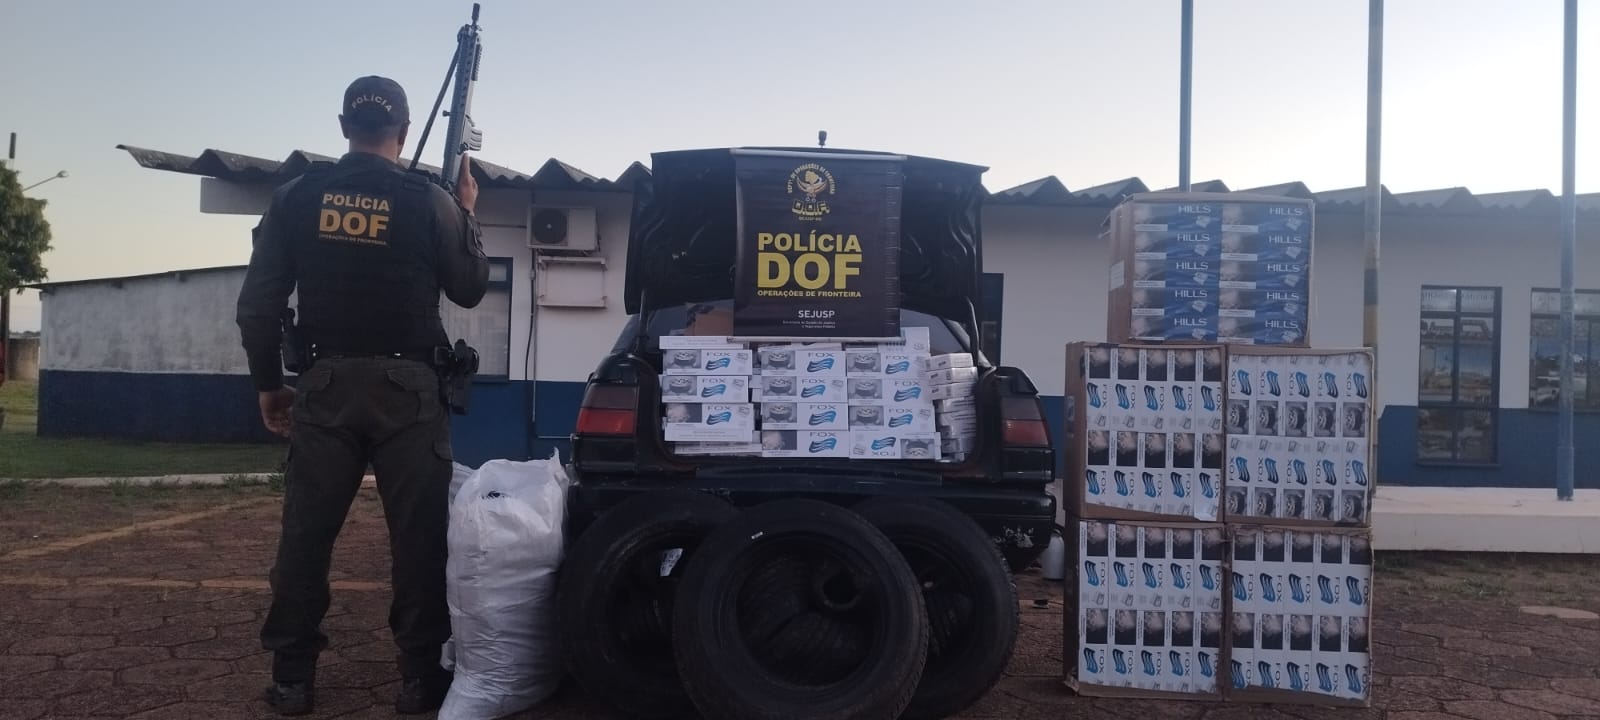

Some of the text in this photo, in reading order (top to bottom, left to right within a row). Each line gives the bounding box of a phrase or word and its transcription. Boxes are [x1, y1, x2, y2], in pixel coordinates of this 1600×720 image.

[351, 93, 393, 113] POLÍCIA
[322, 192, 390, 211] POLÍCIA
[1178, 205, 1211, 213] HILLS
[1269, 207, 1303, 216] HILLS
[319, 208, 390, 238] DOF
[758, 229, 862, 252] POLÍCIA
[1177, 233, 1210, 242] HILLS
[1268, 235, 1302, 244] HILLS
[1176, 262, 1208, 270] HILLS
[1267, 264, 1300, 272] HILLS
[757, 252, 863, 290] DOF
[757, 289, 804, 299] OPERAÇÕES
[817, 290, 862, 298] FRONTEIRA
[1175, 290, 1208, 298] HILLS
[1266, 292, 1299, 300] HILLS
[797, 310, 835, 319] SEJUSP
[1174, 318, 1208, 326] HILLS
[1265, 320, 1299, 329] HILLS
